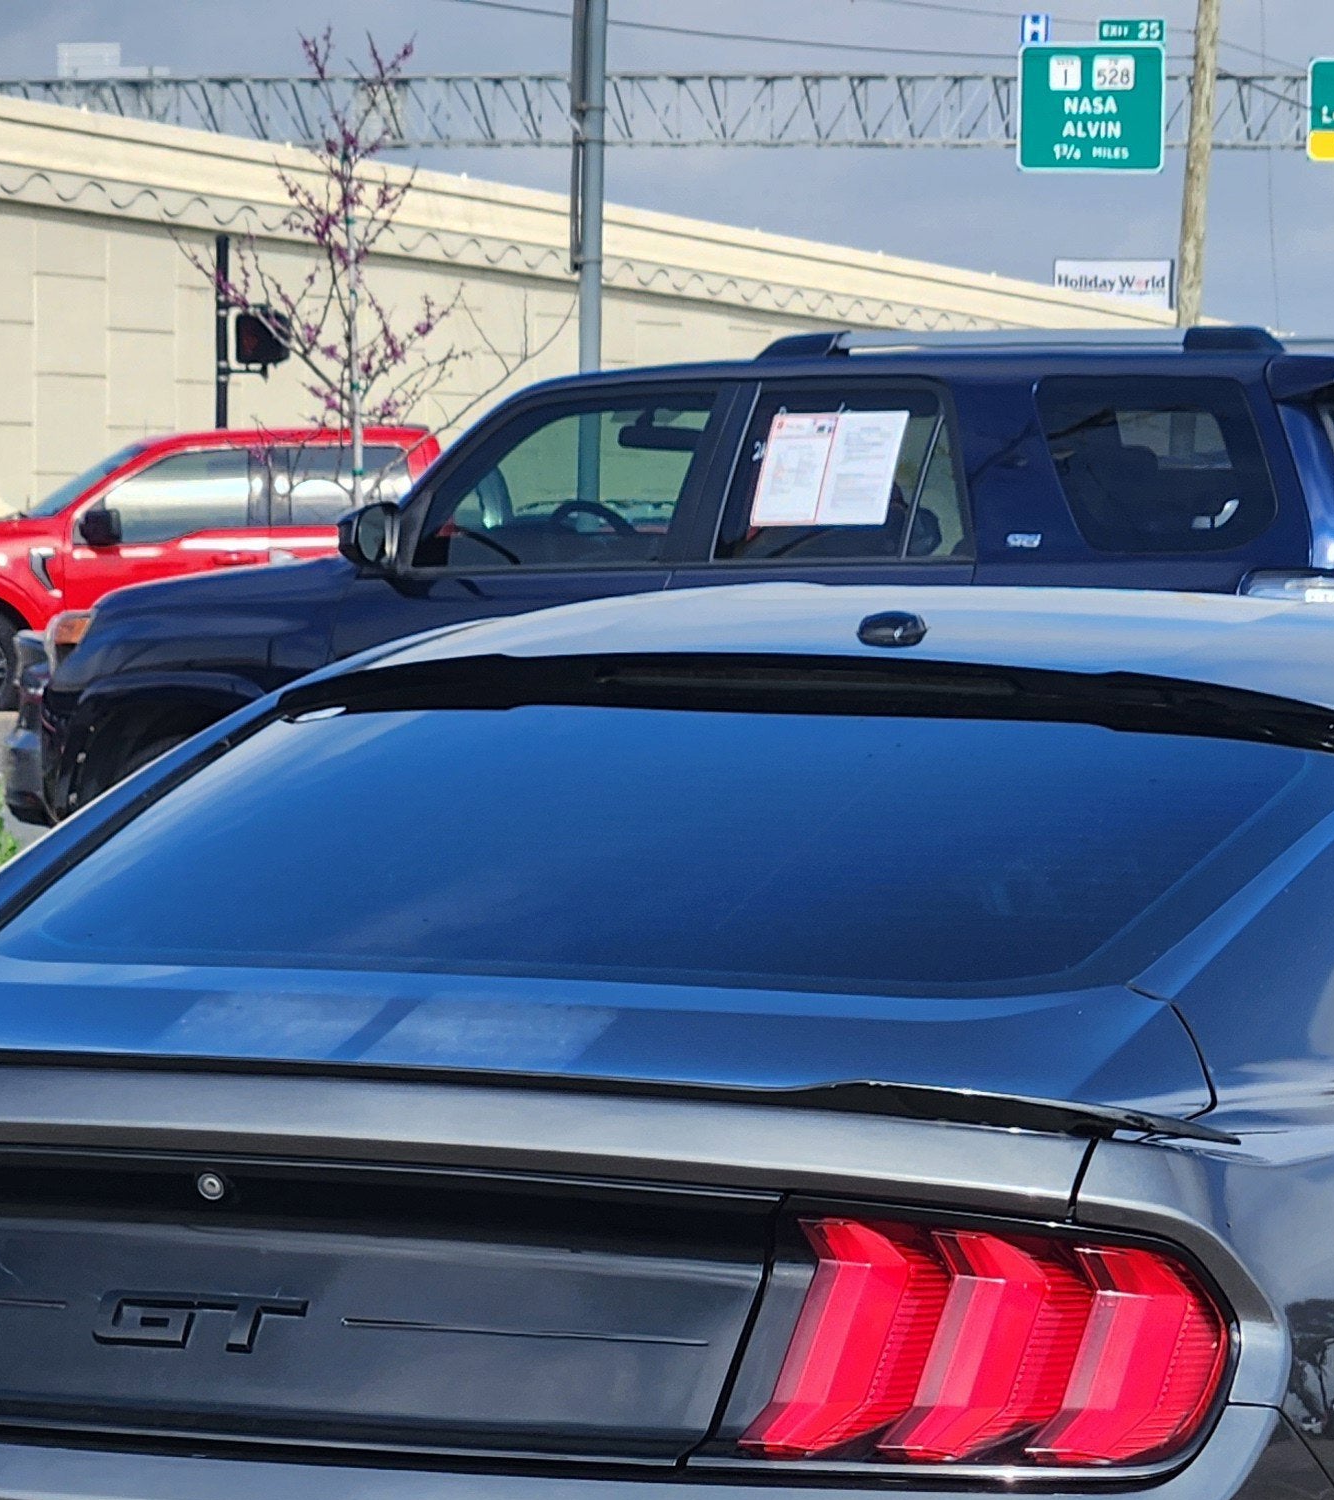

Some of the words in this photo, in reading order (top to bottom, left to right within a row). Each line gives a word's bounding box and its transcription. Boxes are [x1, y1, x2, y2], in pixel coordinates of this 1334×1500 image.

[1101, 23, 1129, 37] EXIT
[1137, 21, 1161, 39] 25
[1097, 68, 1130, 86] 528
[1064, 96, 1118, 115] NASA
[1062, 120, 1122, 139] ALVIN
[1092, 146, 1130, 159] MILES
[1058, 273, 1115, 292] Holiday
[92, 1290, 310, 1354] GT
